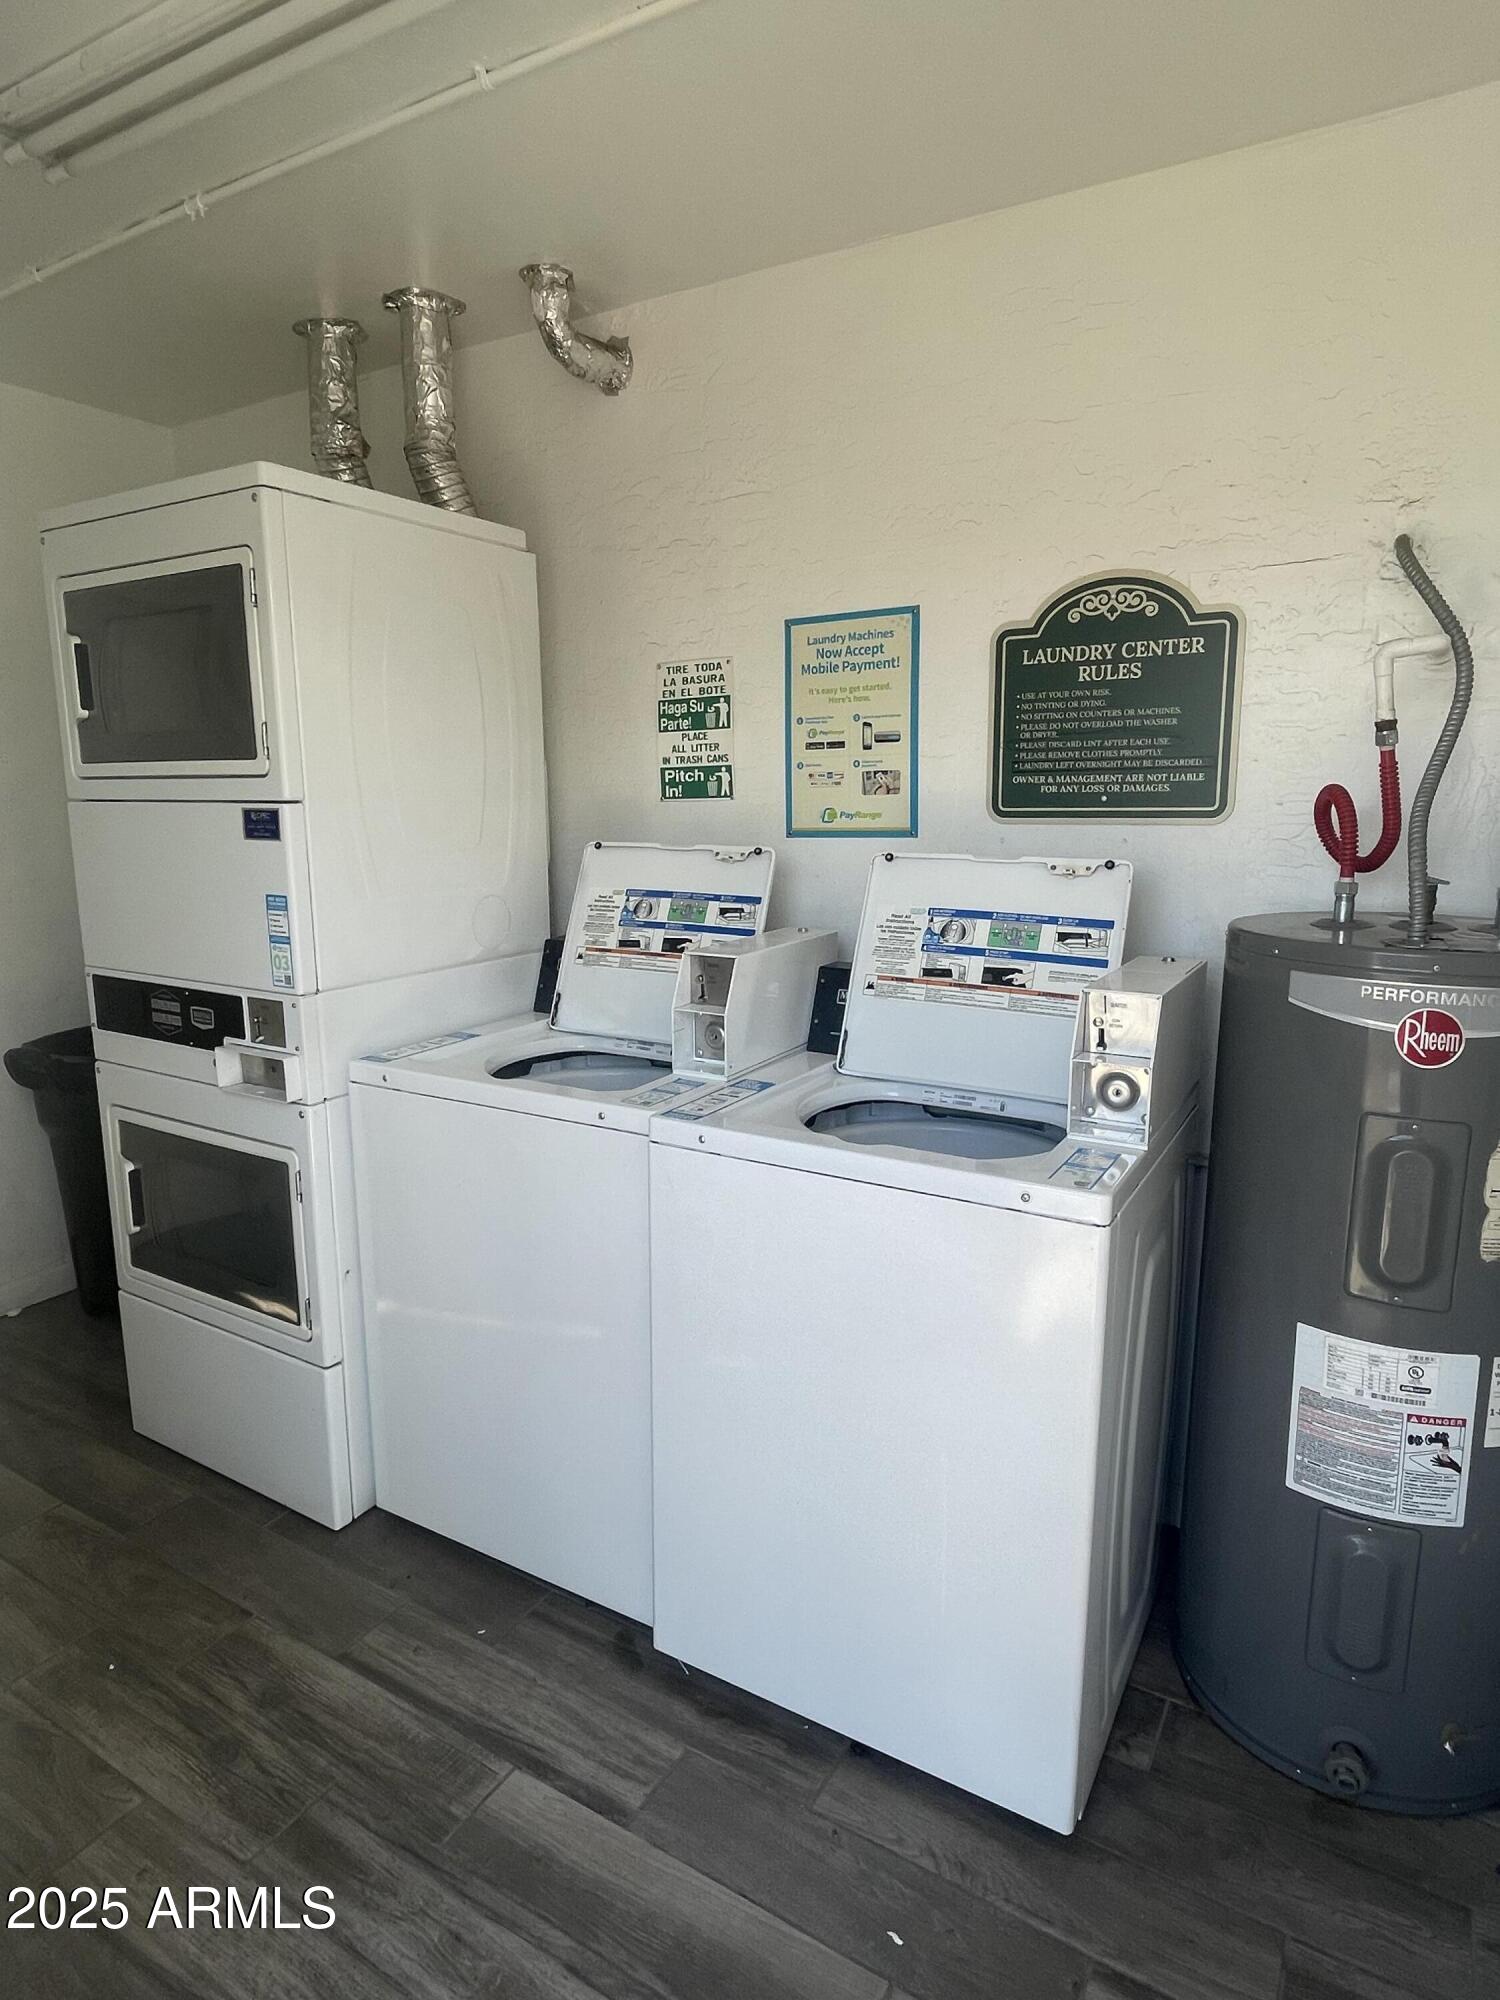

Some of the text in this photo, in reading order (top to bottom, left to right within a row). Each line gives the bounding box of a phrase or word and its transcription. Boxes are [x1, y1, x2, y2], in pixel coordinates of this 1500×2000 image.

[807, 629, 894, 645] Laundry Machines
[816, 643, 884, 659] Now Accept
[1023, 637, 1205, 665] LAUNDRY CENTER
[666, 662, 722, 674] TIRE TODA
[801, 656, 900, 675] Mobile Payment!
[1078, 662, 1142, 681] RULES
[664, 674, 725, 687] LA BASURA
[663, 685, 726, 698] EN EL BOTE
[821, 687, 838, 695] easy
[849, 685, 860, 694] get
[1049, 690, 1069, 698] YOUR
[660, 700, 704, 717] Haga Su
[1034, 701, 1066, 709] TINTING
[1080, 709, 1122, 717] COUNTERS
[661, 717, 692, 731] Parte!
[1081, 720, 1123, 728] OVERLOAD
[1144, 718, 1178, 726] WASHER
[682, 732, 708, 741] PLACE
[672, 743, 719, 753] ALL LITTER
[675, 756, 702, 764] TRASH
[707, 754, 728, 763] CANS
[1082, 750, 1118, 758] CLOTHES
[1076, 760, 1121, 768] OVERNIGHT
[665, 769, 704, 782] Pitch
[1056, 774, 1123, 782] MANAGEMENT
[1170, 773, 1205, 781] LIABLE
[665, 785, 682, 797] In!
[1041, 785, 1058, 793] FOR
[840, 811, 882, 820] PayRange
[1403, 1010, 1460, 1058] Rheem
[1421, 1417, 1463, 1426] DANGER
